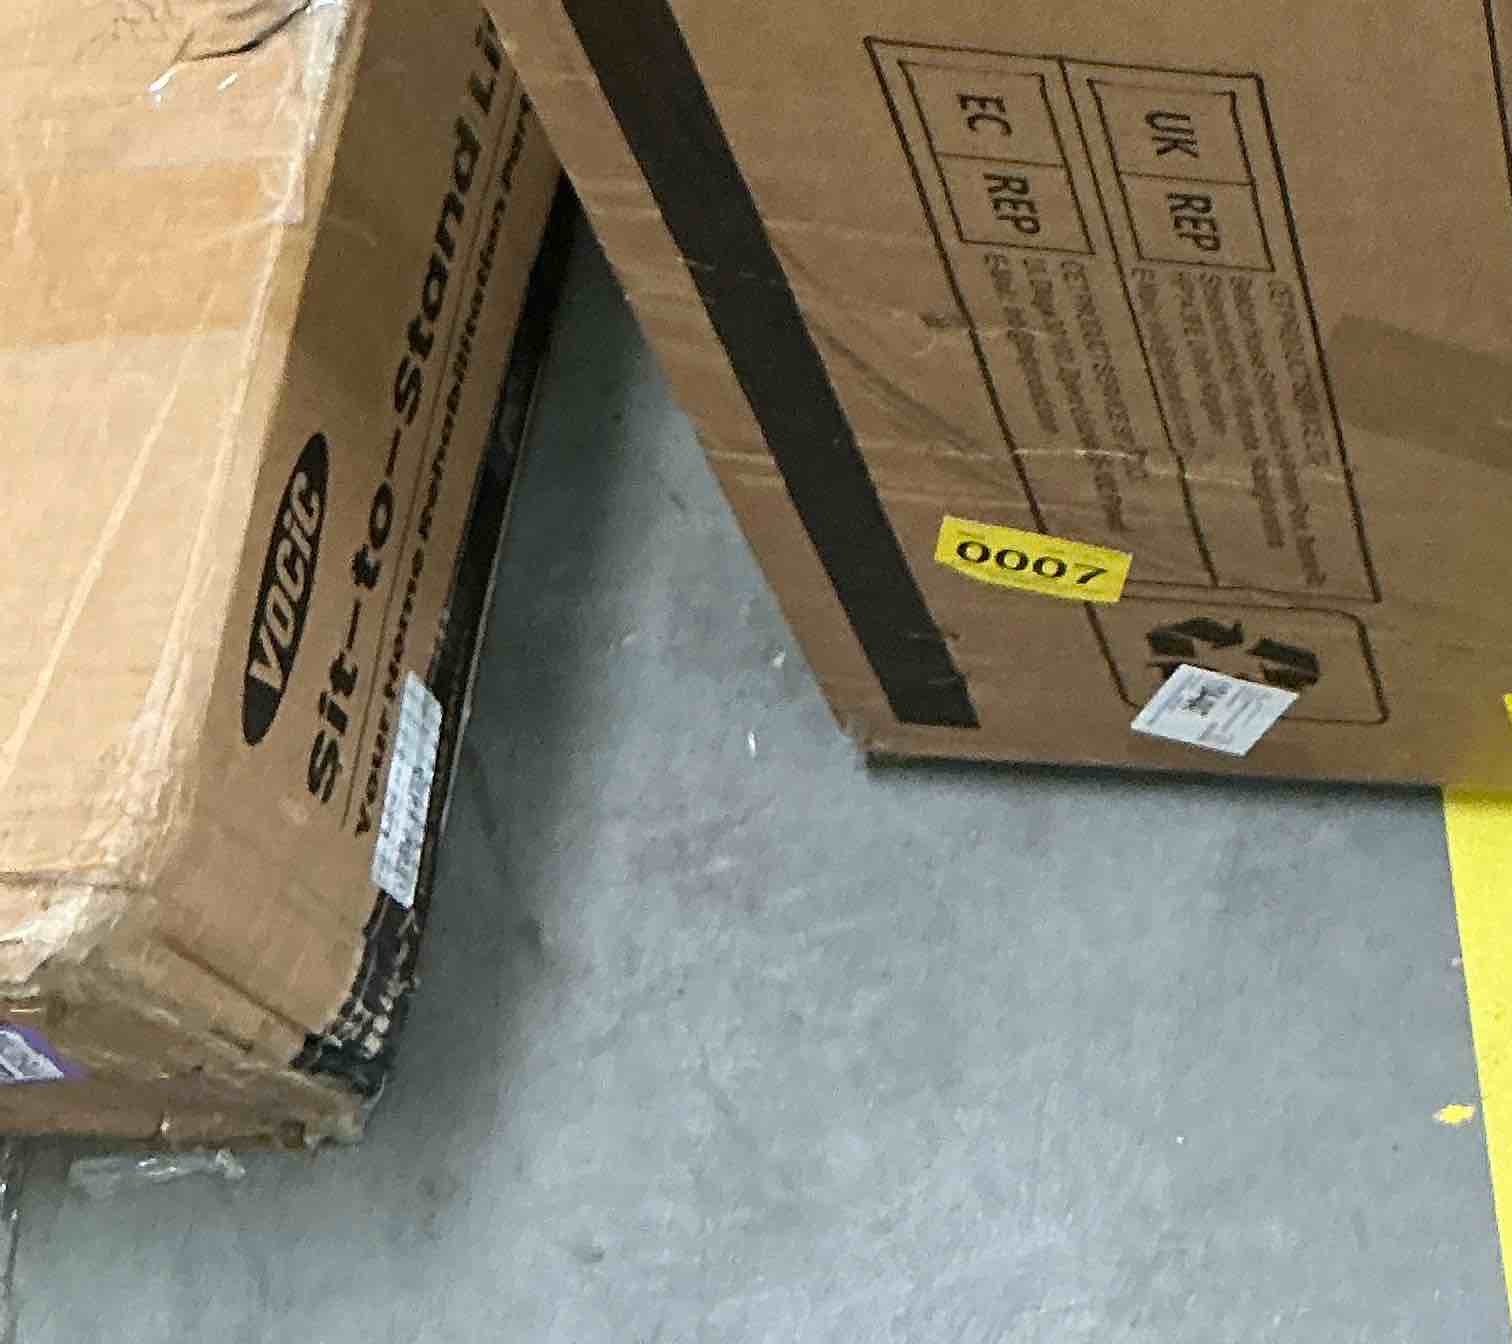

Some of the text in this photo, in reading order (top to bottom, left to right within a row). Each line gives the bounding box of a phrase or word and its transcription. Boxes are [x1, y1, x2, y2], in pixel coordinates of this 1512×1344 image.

[957, 92, 1012, 138] EC
[1145, 109, 1200, 160] UK
[983, 172, 1042, 237] REP
[1167, 192, 1221, 254] REP
[307, 115, 481, 804] Sit-to-Stand
[955, 539, 1110, 587] 0007
